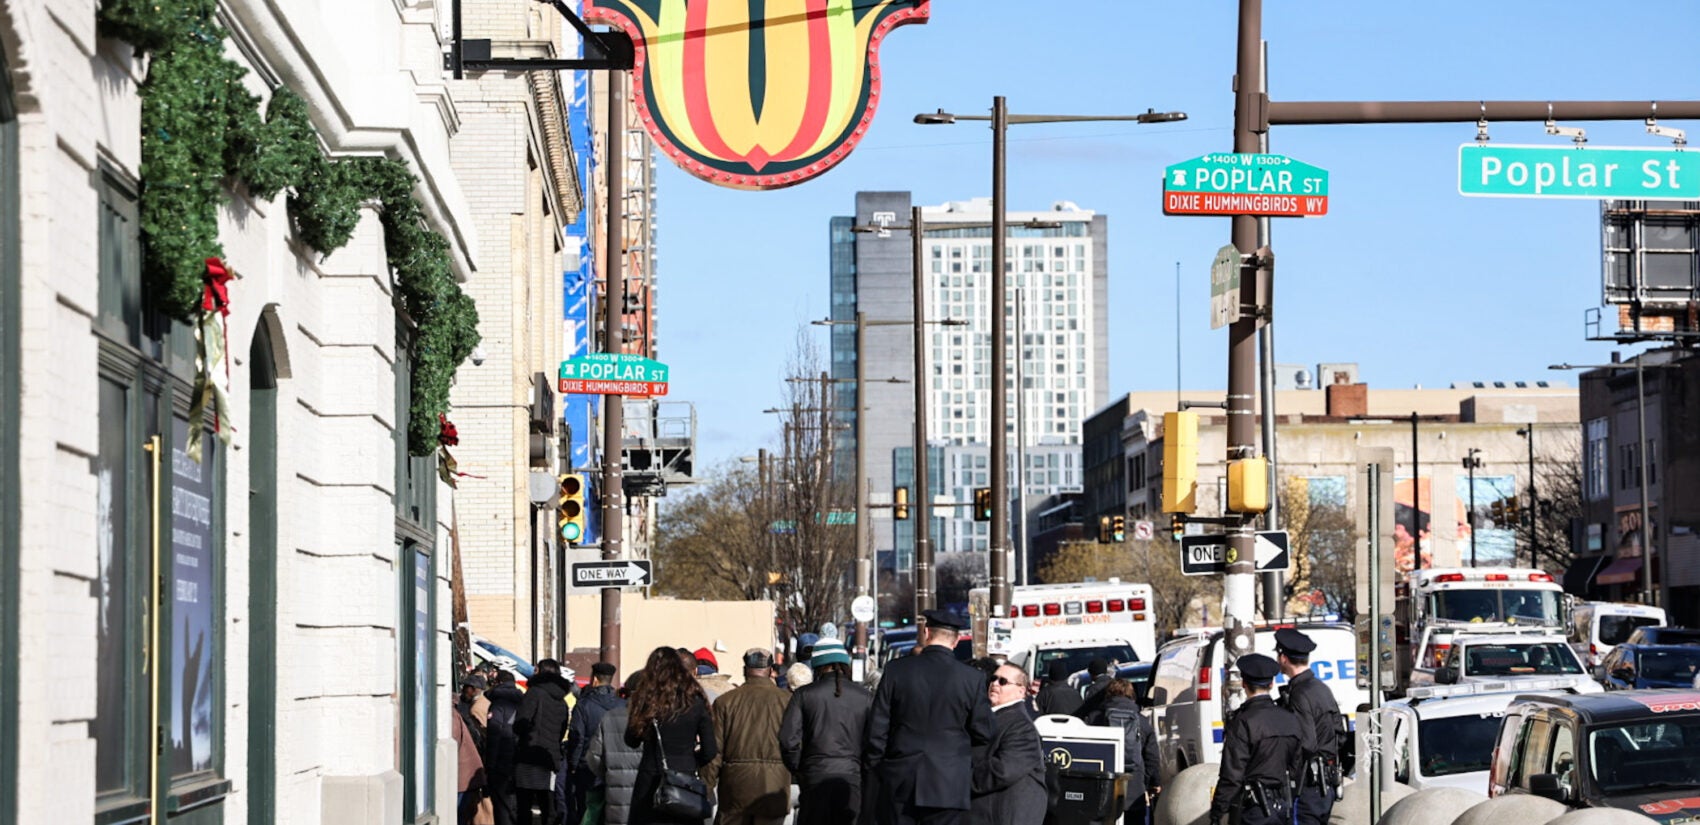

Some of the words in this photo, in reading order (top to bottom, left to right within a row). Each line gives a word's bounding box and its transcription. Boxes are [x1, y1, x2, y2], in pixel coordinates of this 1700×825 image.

[1213, 155, 1236, 164] 1400
[1240, 154, 1253, 166] W
[1256, 156, 1281, 166] 1300
[1196, 168, 1293, 192] POPLAR
[1303, 178, 1322, 194] ST
[1481, 156, 1618, 194] Poplar
[1642, 159, 1681, 188] St
[1169, 195, 1200, 210] DIXIE
[1204, 196, 1297, 212] HUMMINGBIRDS
[1306, 198, 1324, 213] WY
[610, 354, 618, 362] W
[580, 363, 645, 380] POPLAR
[651, 370, 665, 381] ST
[562, 380, 583, 391] DIXIE
[586, 382, 648, 394] HUMMINGBIRDS
[653, 384, 666, 394] WY
[1193, 546, 1221, 562] ONE
[580, 569, 602, 580] ONE
[606, 568, 627, 578] WAY
